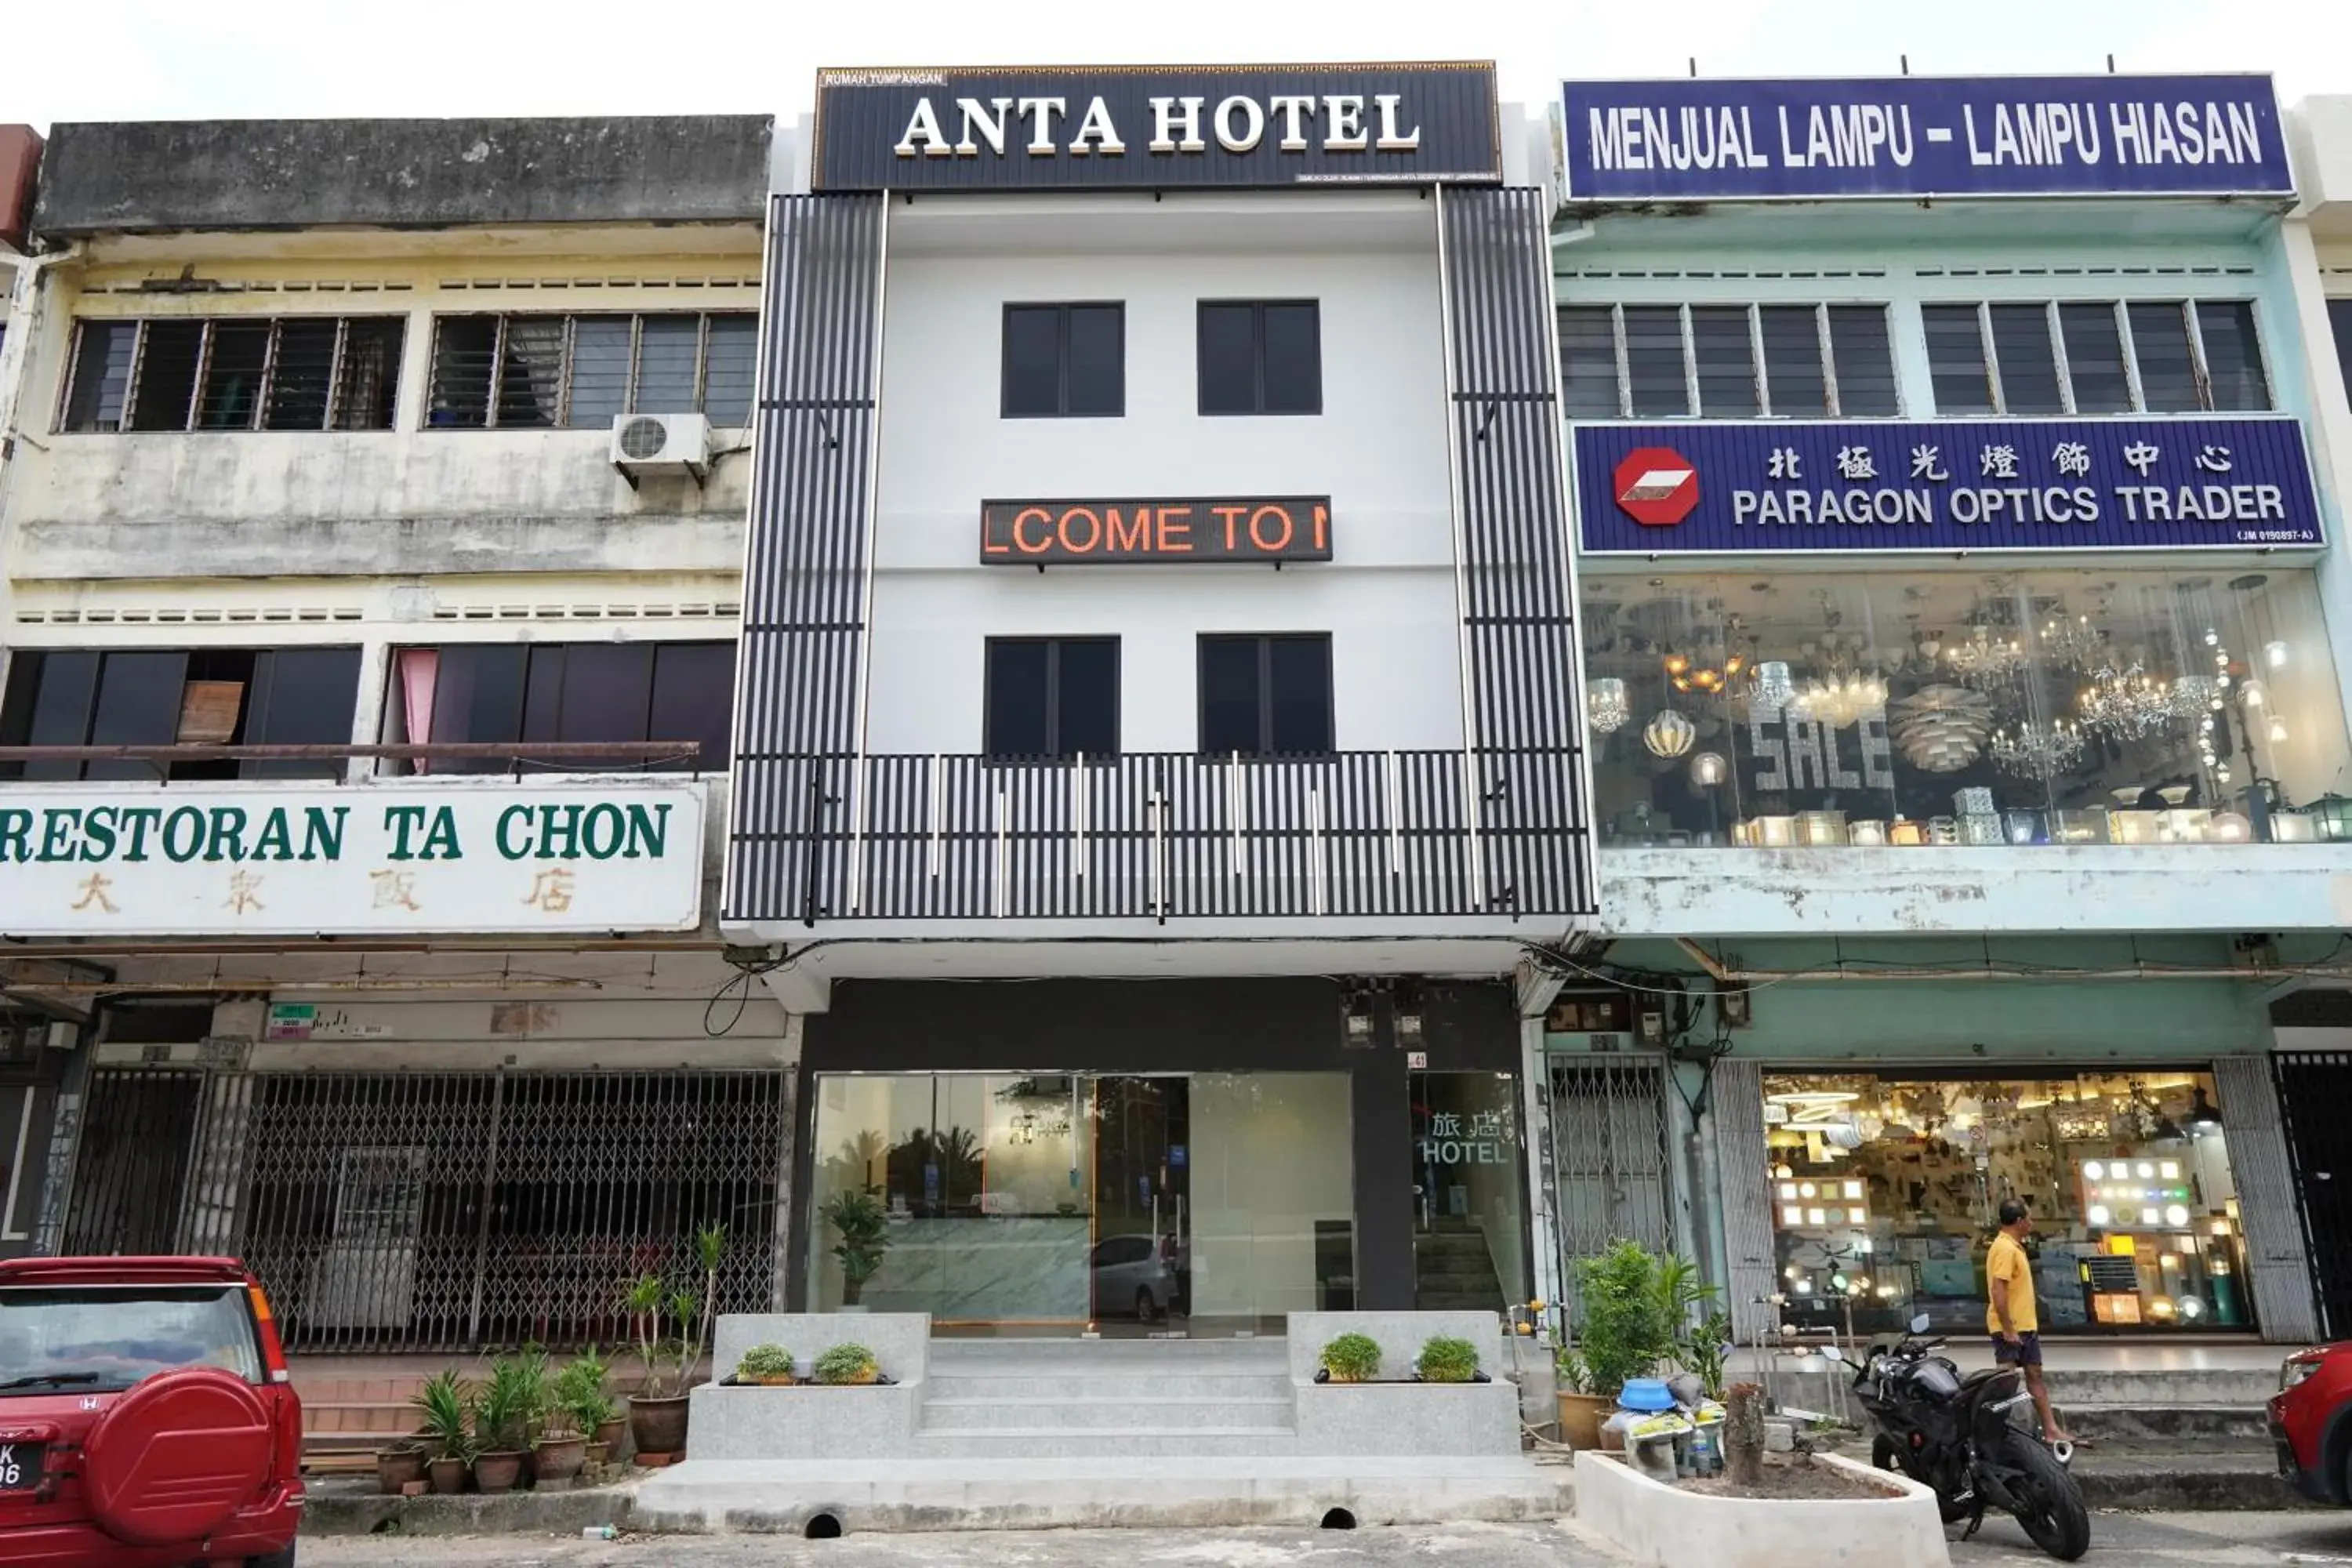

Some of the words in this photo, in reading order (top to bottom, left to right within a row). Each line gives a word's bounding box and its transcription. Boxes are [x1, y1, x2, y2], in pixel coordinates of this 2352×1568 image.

[826, 74, 866, 85] RUMAH
[871, 73, 942, 85] TUMPANGAN
[894, 96, 1125, 154] ANTA
[1149, 94, 1420, 151] HOTEL
[1589, 106, 1769, 170] MENJUAL
[1778, 104, 1914, 167] LAMPU
[1926, 128, 1953, 142] -
[1963, 103, 2100, 165] LAMPU
[2110, 101, 2265, 165] HIASAN
[1768, 441, 2232, 479] 北極光燈飾中心
[1733, 488, 1933, 524] PARAGON
[1950, 487, 2099, 523] OPTICS
[2115, 485, 2285, 521] TRADER
[985, 506, 1192, 554] LCOME
[1212, 506, 1294, 550] TO
[1749, 705, 1895, 790] SALE
[0, 806, 349, 862] RESTORAN
[385, 805, 463, 860] TA
[496, 802, 673, 860] CHON
[1432, 1110, 1500, 1138] 旅店
[1423, 1141, 1508, 1163] HOTEL
